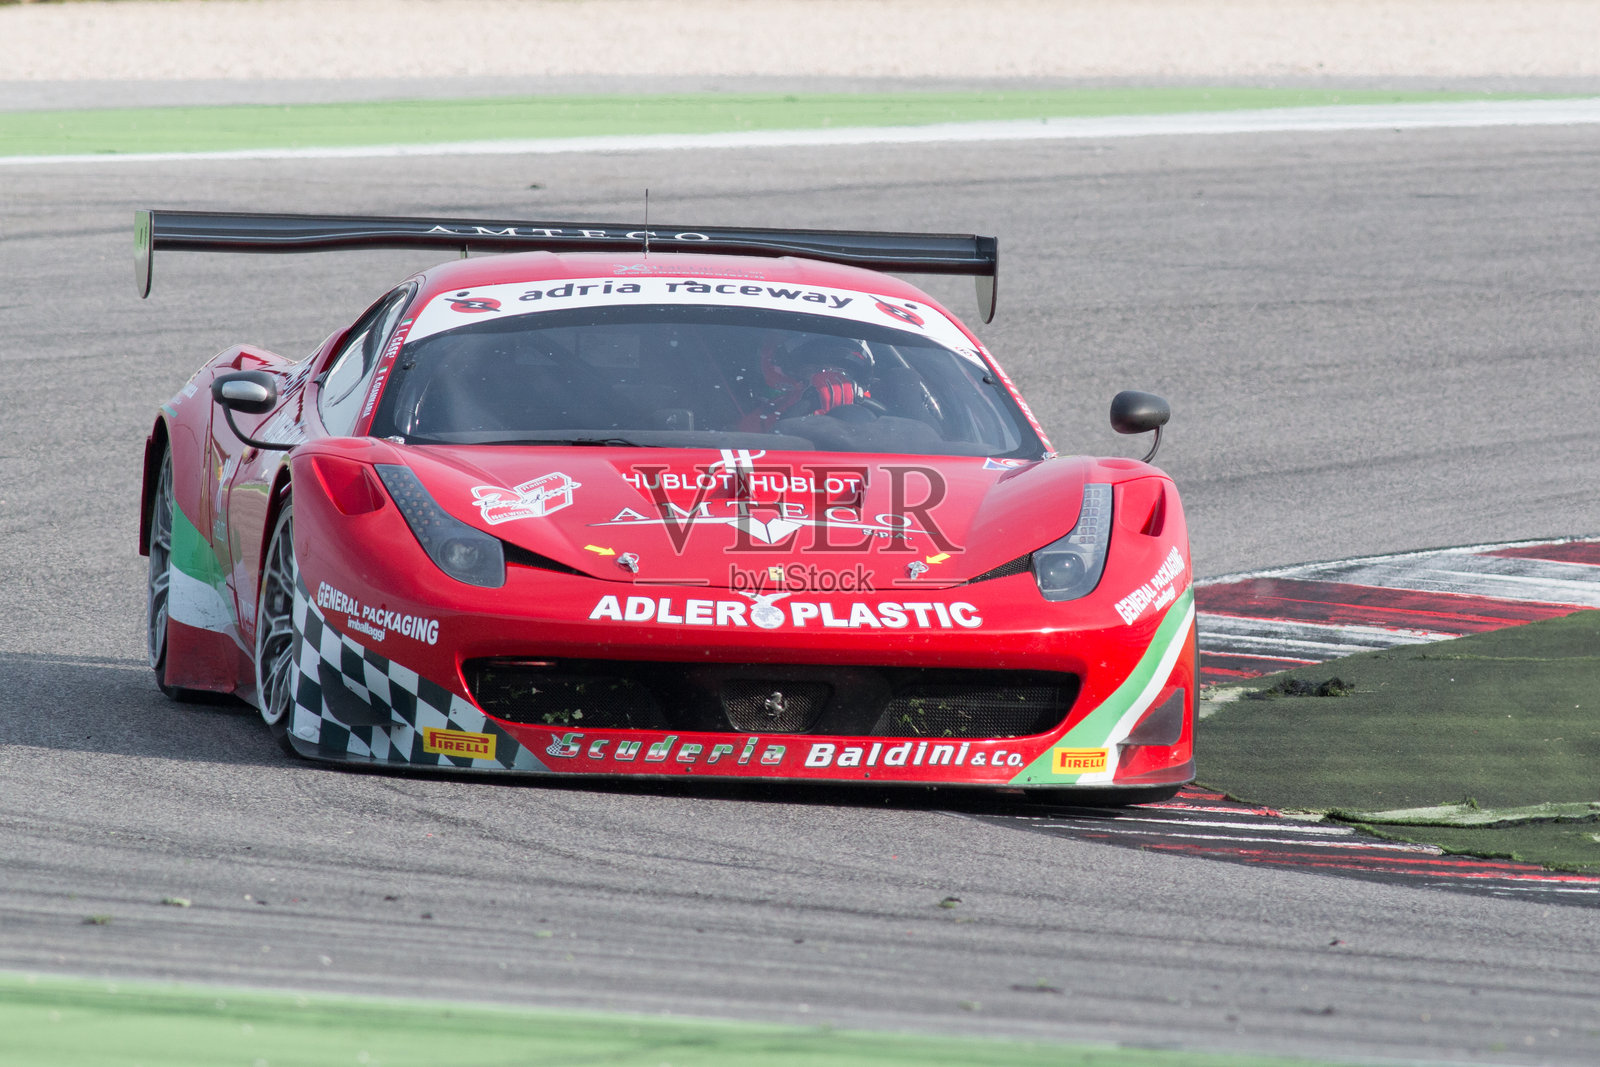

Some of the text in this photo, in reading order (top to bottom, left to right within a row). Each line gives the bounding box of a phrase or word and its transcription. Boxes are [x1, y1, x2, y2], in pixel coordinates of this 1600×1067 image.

[427, 225, 710, 241] AMTECO
[519, 280, 853, 309] adria raceway
[621, 472, 734, 490] HUBLOT
[749, 474, 860, 494] HUBLOT
[610, 501, 913, 528] AMTECO
[317, 580, 439, 646] GENERAL PACKAGING
[588, 594, 984, 629] ADLER PLASTIC
[1114, 583, 1157, 625] GENERAL
[347, 615, 386, 642] imballaggi
[429, 731, 490, 755] PIRELLI
[547, 732, 787, 766] Scuderia
[803, 741, 971, 768] Baldini
[1060, 751, 1106, 769] PIRELLI
